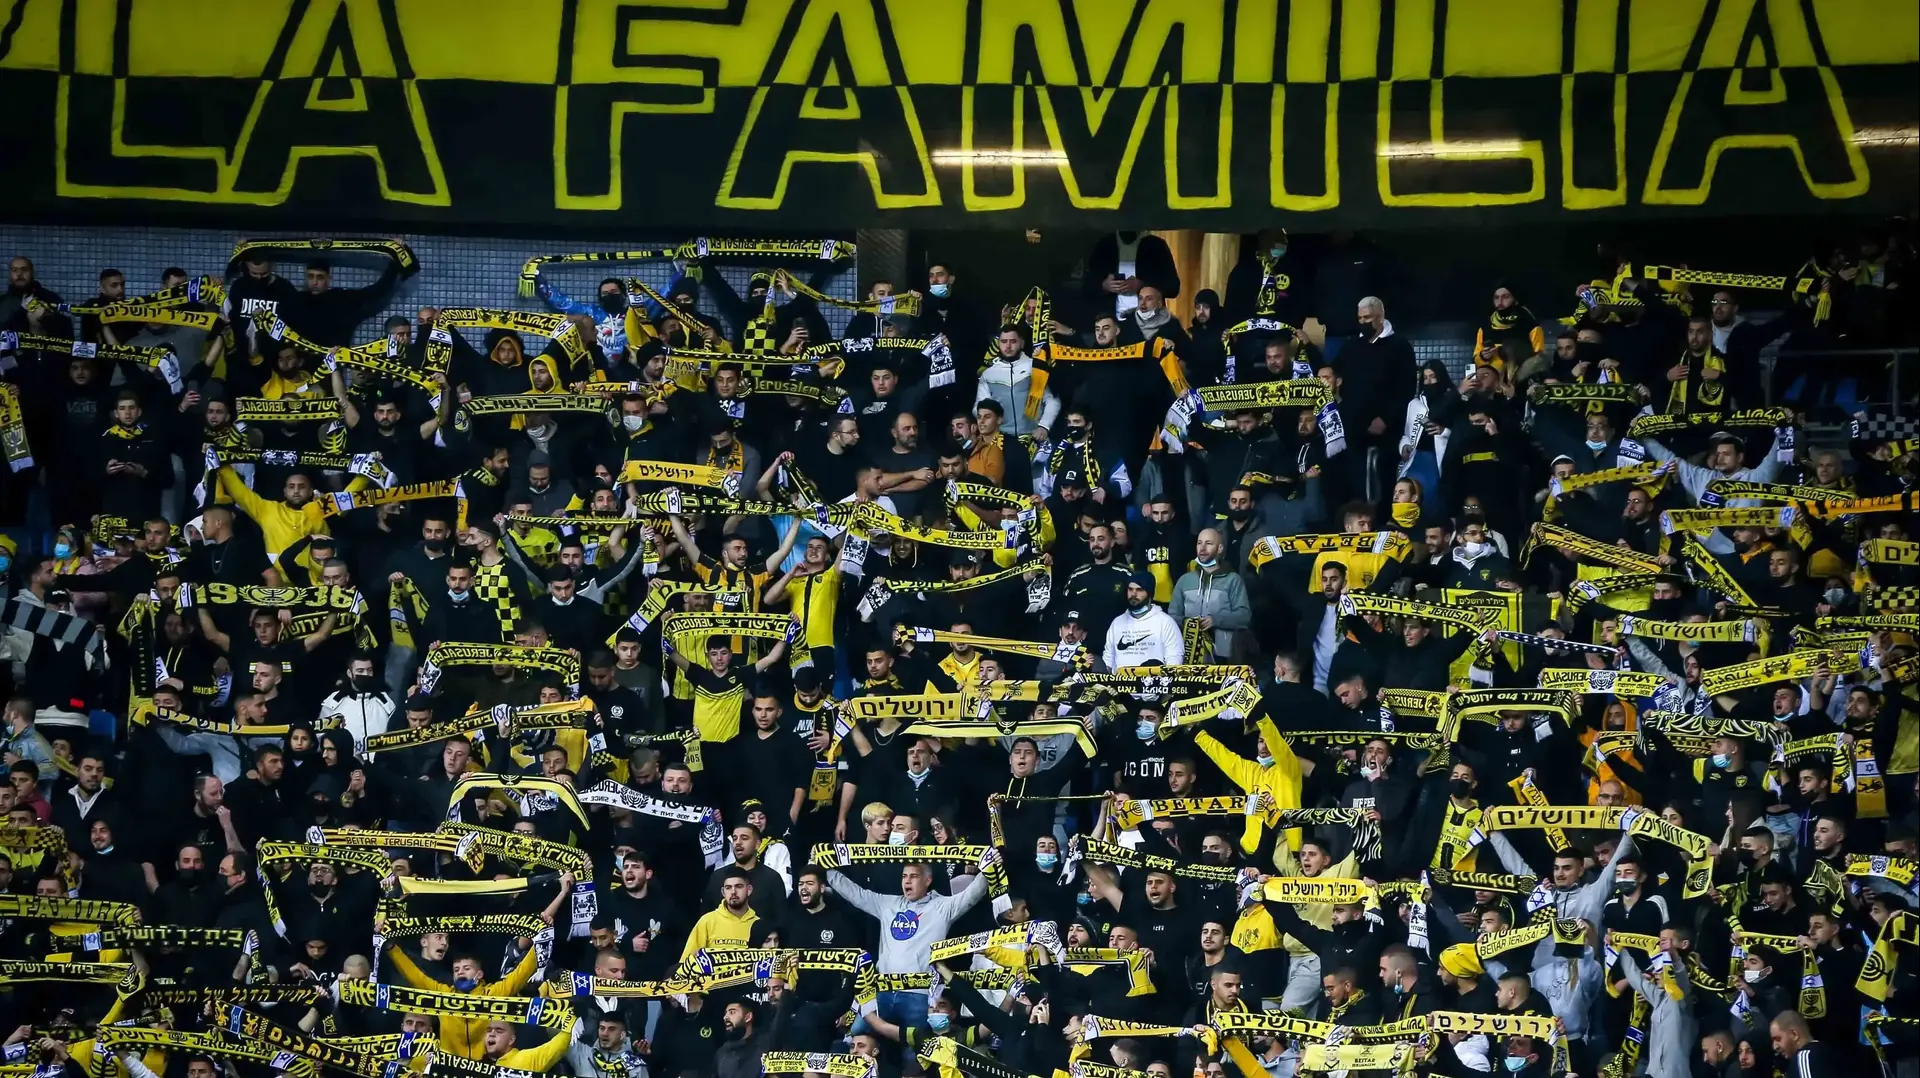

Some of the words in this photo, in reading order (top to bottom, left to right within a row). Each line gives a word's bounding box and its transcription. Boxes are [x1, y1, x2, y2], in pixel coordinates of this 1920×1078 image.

[52, 0, 452, 206] LA
[553, 0, 1872, 211] FAMILIA
[104, 306, 164, 320] ירושלים
[240, 298, 279, 318] DIESEL
[875, 340, 928, 350] JERUSALEM
[754, 377, 820, 396] Jerusalem
[1552, 387, 1624, 398] ירושלים
[299, 456, 349, 468] JERUSALEM
[640, 465, 693, 478] ירושלים
[1282, 534, 1375, 552] BETAR
[196, 582, 238, 605] 19
[304, 585, 354, 609] 36
[1459, 597, 1486, 606] ירושלים
[1355, 597, 1407, 612] ירושלים
[1651, 622, 1724, 638] ירושלים
[1171, 686, 1189, 694] 1936
[1521, 691, 1551, 702] בית״ר
[1455, 693, 1493, 706] ירושלים
[859, 699, 952, 717] ירושלים
[793, 717, 814, 731] NIK
[368, 728, 411, 749] ירושלים
[1124, 761, 1165, 776] ICON
[1151, 797, 1244, 813] BETAR
[1498, 808, 1595, 826] ירושלים
[1641, 818, 1684, 845] ירושלים
[345, 837, 376, 846] BEITAR
[384, 838, 438, 849] JERUSALEM
[851, 846, 909, 856] JERUSALEM
[1086, 838, 1138, 859] ירושלים
[930, 846, 984, 858] ירושלים
[324, 847, 392, 876] JERUSALEM
[1453, 871, 1516, 889] ירושלים
[1281, 880, 1325, 898] ירושלים
[1326, 880, 1358, 897] בית״ר
[1281, 895, 1308, 903] BEITAR
[1308, 895, 1347, 903] JERUSALEM
[479, 913, 546, 931] JERUSALEM
[892, 920, 917, 930] NASA
[103, 927, 172, 943] ירושלים
[177, 928, 243, 943] בית״ר
[1480, 941, 1507, 956] BEITAR
[3, 962, 55, 975] ירושלים
[57, 962, 96, 976] בית״ר
[203, 986, 226, 1002] של
[230, 986, 273, 1003] הדגל
[1231, 1014, 1318, 1033] ירושלים
[1438, 1014, 1553, 1034] ירושלים
[430, 1050, 496, 1077] JERUSALEM
